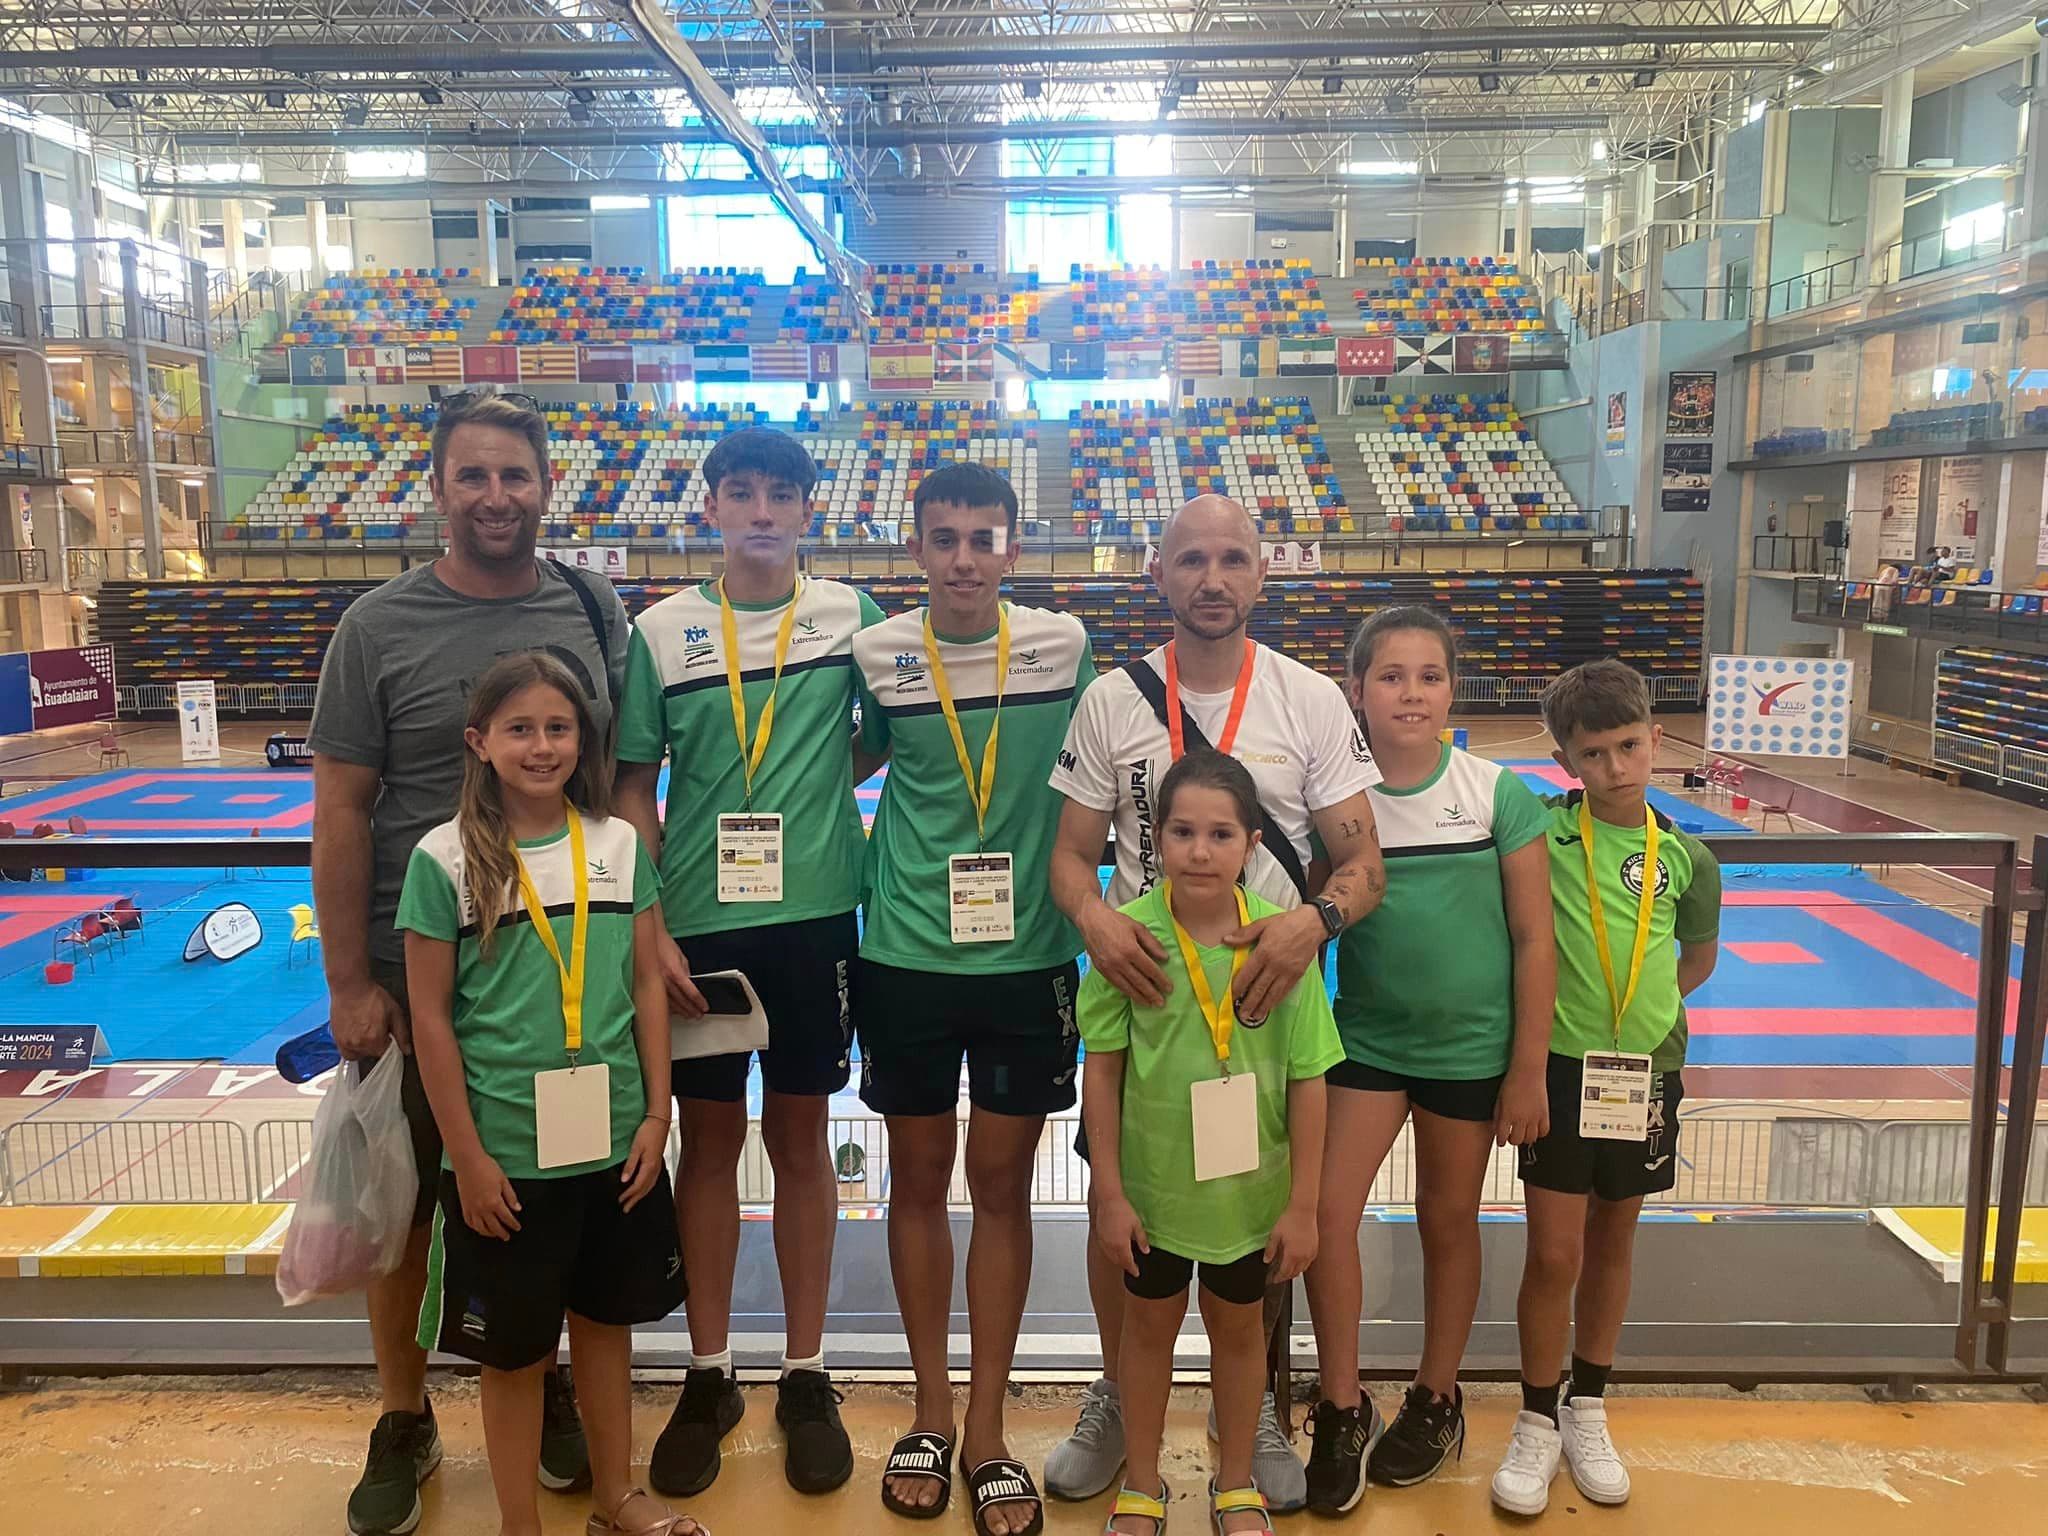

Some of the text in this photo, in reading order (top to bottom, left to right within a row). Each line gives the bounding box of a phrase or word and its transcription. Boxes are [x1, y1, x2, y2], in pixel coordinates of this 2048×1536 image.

[792, 633, 834, 646] Extremadura
[1008, 664, 1054, 676] Extremadura
[43, 675, 97, 692] Ayuntamiento de
[44, 688, 99, 707] Guadalajara
[190, 715, 201, 733] 1
[1435, 819, 1477, 829] Extremadura
[16, 1034, 55, 1042] MANCHA
[19, 1044, 53, 1060] 2024
[889, 1451, 935, 1469] PUMA
[977, 1478, 1024, 1502] PUMA
